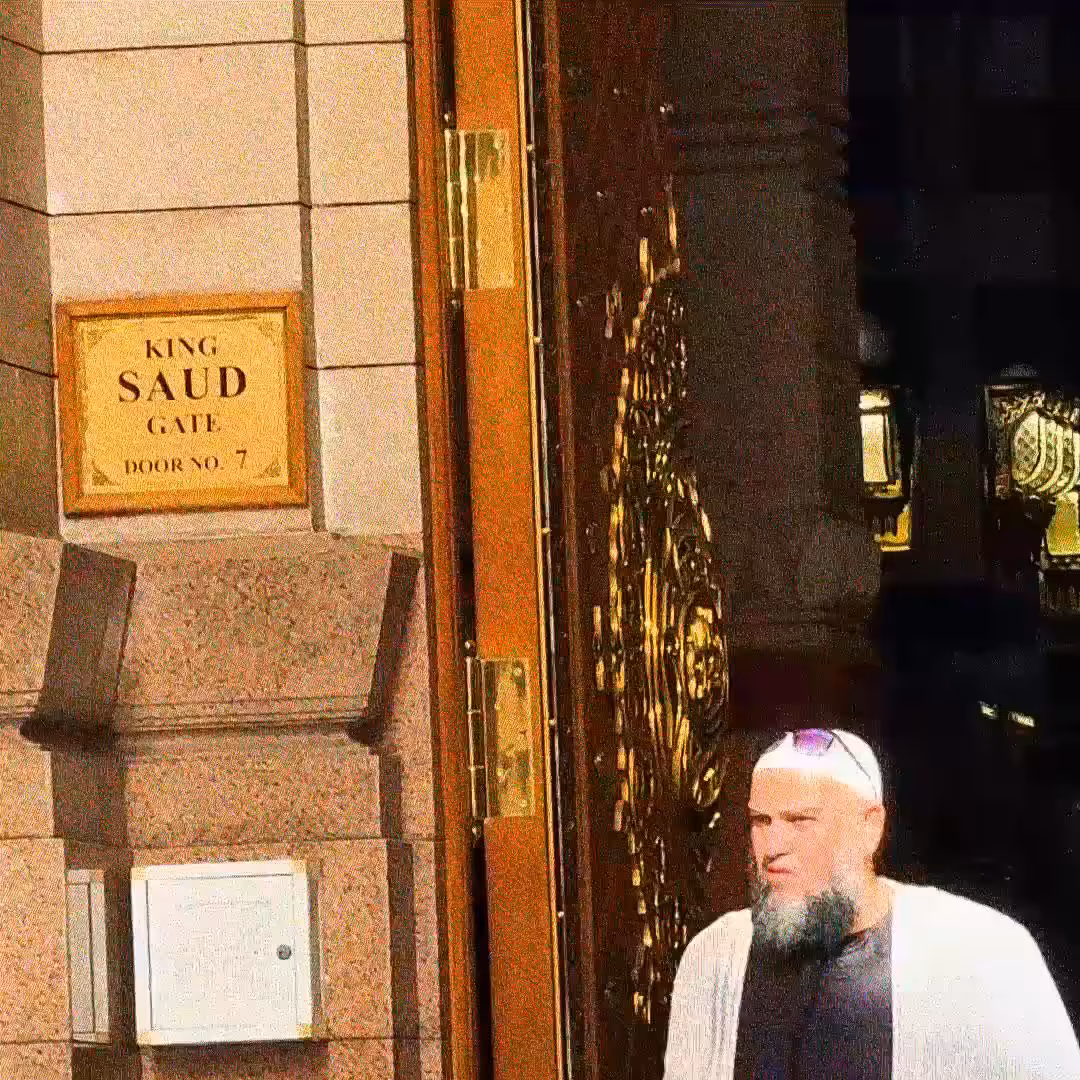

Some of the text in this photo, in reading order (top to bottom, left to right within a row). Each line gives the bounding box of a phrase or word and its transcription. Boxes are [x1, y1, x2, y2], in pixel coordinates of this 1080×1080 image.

[145, 336, 217, 358] KING
[118, 366, 247, 402] SAUD
[147, 413, 221, 434] GATE
[124, 449, 247, 474] DOOR NO. 7
